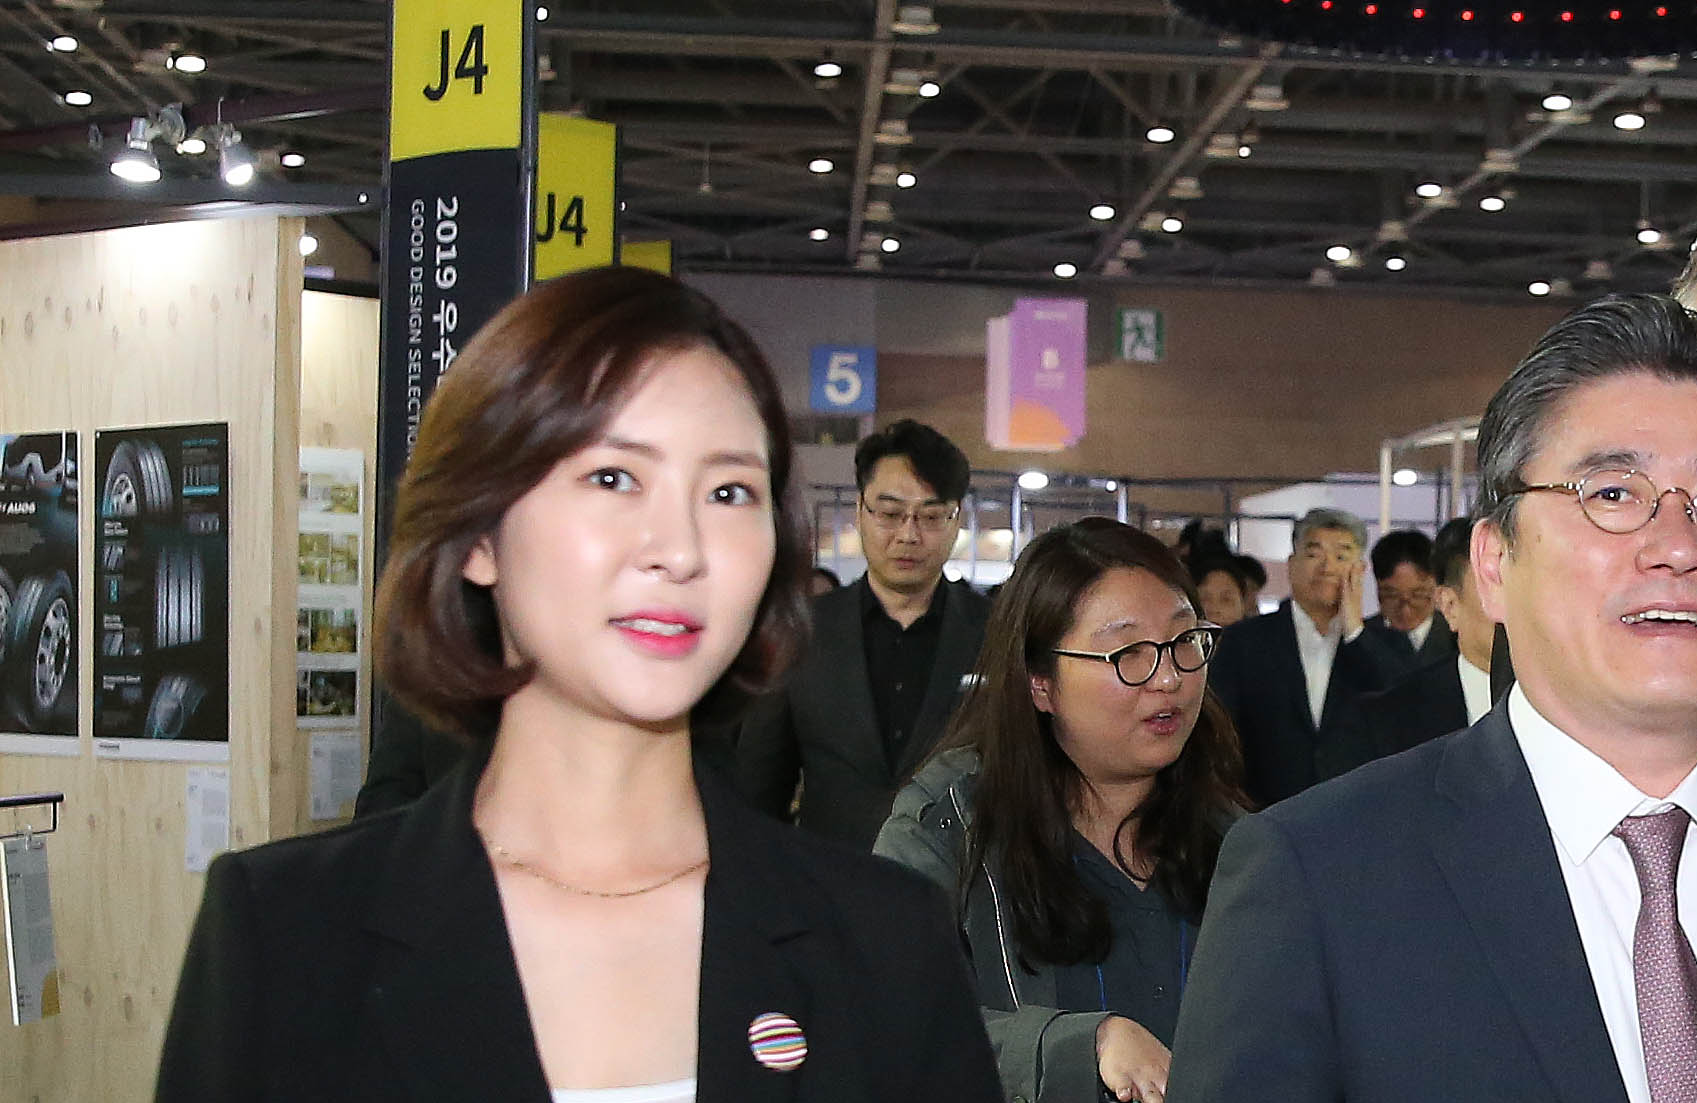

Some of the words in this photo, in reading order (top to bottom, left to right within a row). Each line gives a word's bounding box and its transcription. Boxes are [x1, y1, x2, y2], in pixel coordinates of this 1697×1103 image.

[423, 25, 489, 101] J4
[410, 199, 425, 262] GOOD
[435, 196, 459, 290] 2019
[536, 193, 588, 247] J4
[408, 266, 423, 345] DESIGN
[431, 299, 458, 387] 우수
[824, 352, 863, 405] 5
